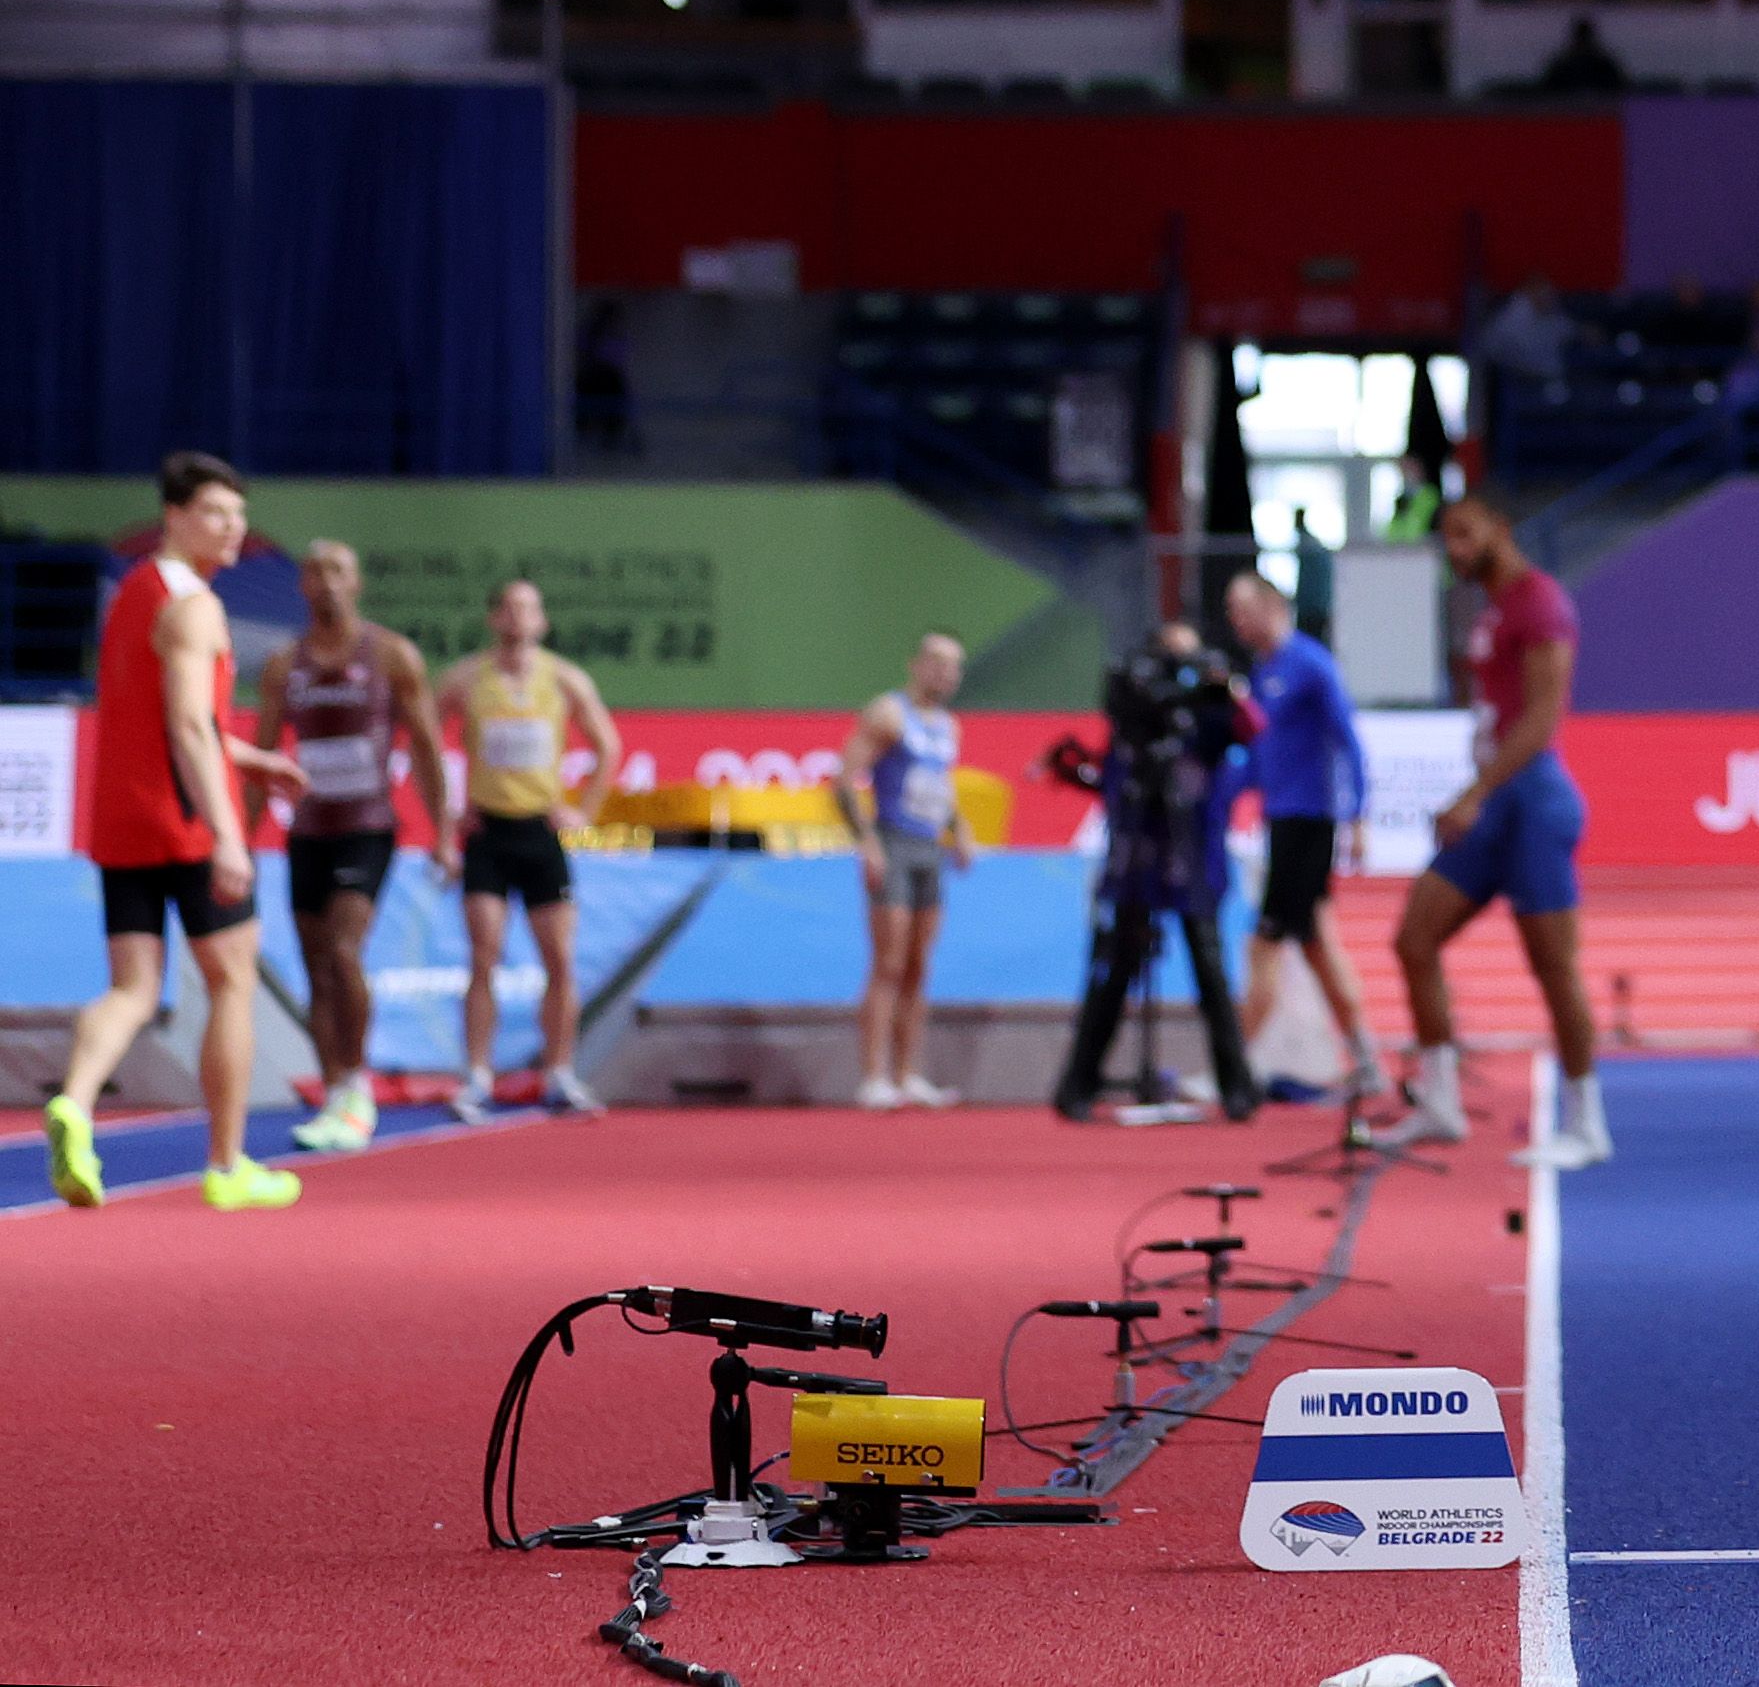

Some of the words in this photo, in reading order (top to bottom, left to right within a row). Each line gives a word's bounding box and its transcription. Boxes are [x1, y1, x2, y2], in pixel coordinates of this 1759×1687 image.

[1329, 1391, 1469, 1417] MONDO
[837, 1442, 944, 1468] SEIKO
[1377, 1509, 1427, 1520] WORLD
[1430, 1508, 1503, 1519] ATHLETICS
[1378, 1532, 1476, 1545] BELGRADE
[1481, 1530, 1504, 1543] 22
